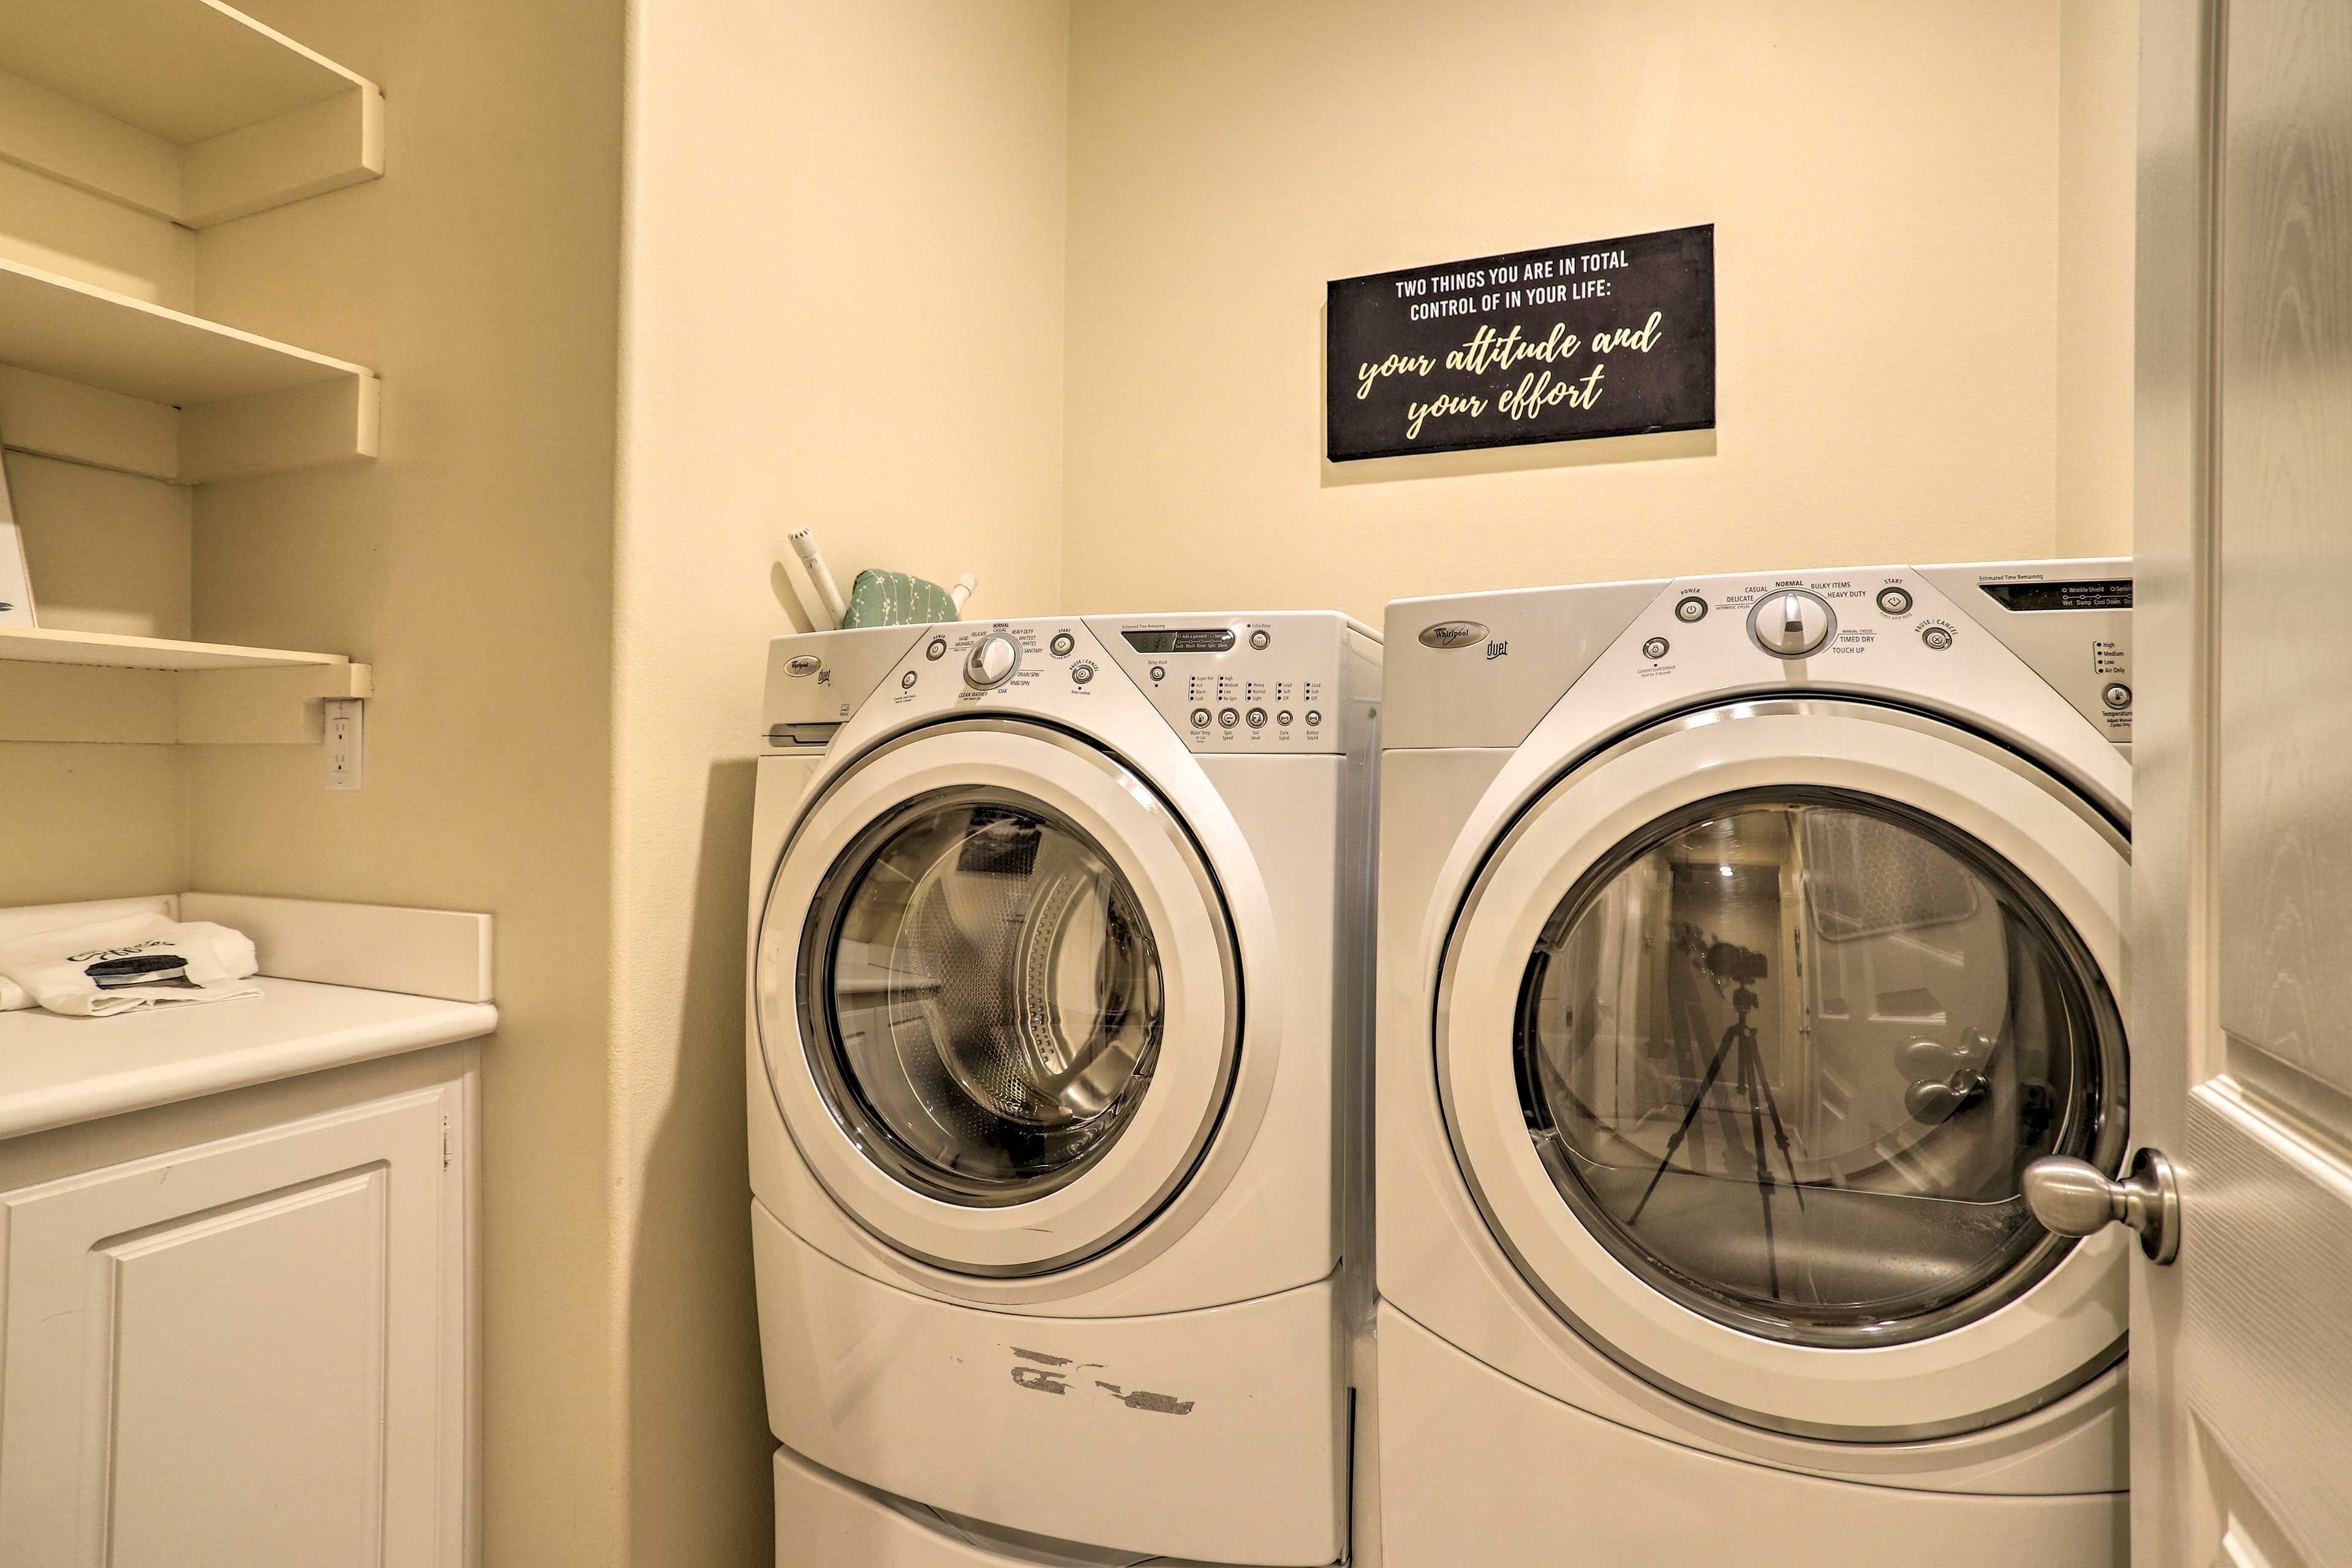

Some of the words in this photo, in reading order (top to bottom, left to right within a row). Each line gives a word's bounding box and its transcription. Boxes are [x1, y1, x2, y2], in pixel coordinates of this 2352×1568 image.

[1395, 278, 1427, 298] TWO
[1431, 270, 1485, 294] THINGS
[1488, 265, 1518, 285] YOU
[1523, 260, 1553, 281] ARE
[1559, 257, 1575, 276] IN
[1581, 249, 1629, 273] TOTAL
[1411, 296, 1477, 321] CONTROL
[1482, 293, 1501, 312] OF
[1506, 290, 1521, 308] IN
[1526, 285, 1567, 306] YOUR
[1572, 279, 1611, 300] LIFE:
[1357, 353, 1436, 399] your
[1446, 322, 1581, 375] attitude
[1592, 311, 1662, 353] and
[1406, 394, 1488, 440] your
[1498, 364, 1605, 421] effort
[1436, 630, 1468, 638] Whirlpool
[1915, 620, 1931, 633] PAUSE
[1937, 619, 1958, 635] CANCEL
[1487, 640, 1508, 660] duet
[1069, 660, 1082, 671] PAUSE
[1085, 659, 1099, 672] CANCEL
[818, 669, 831, 684] duet
